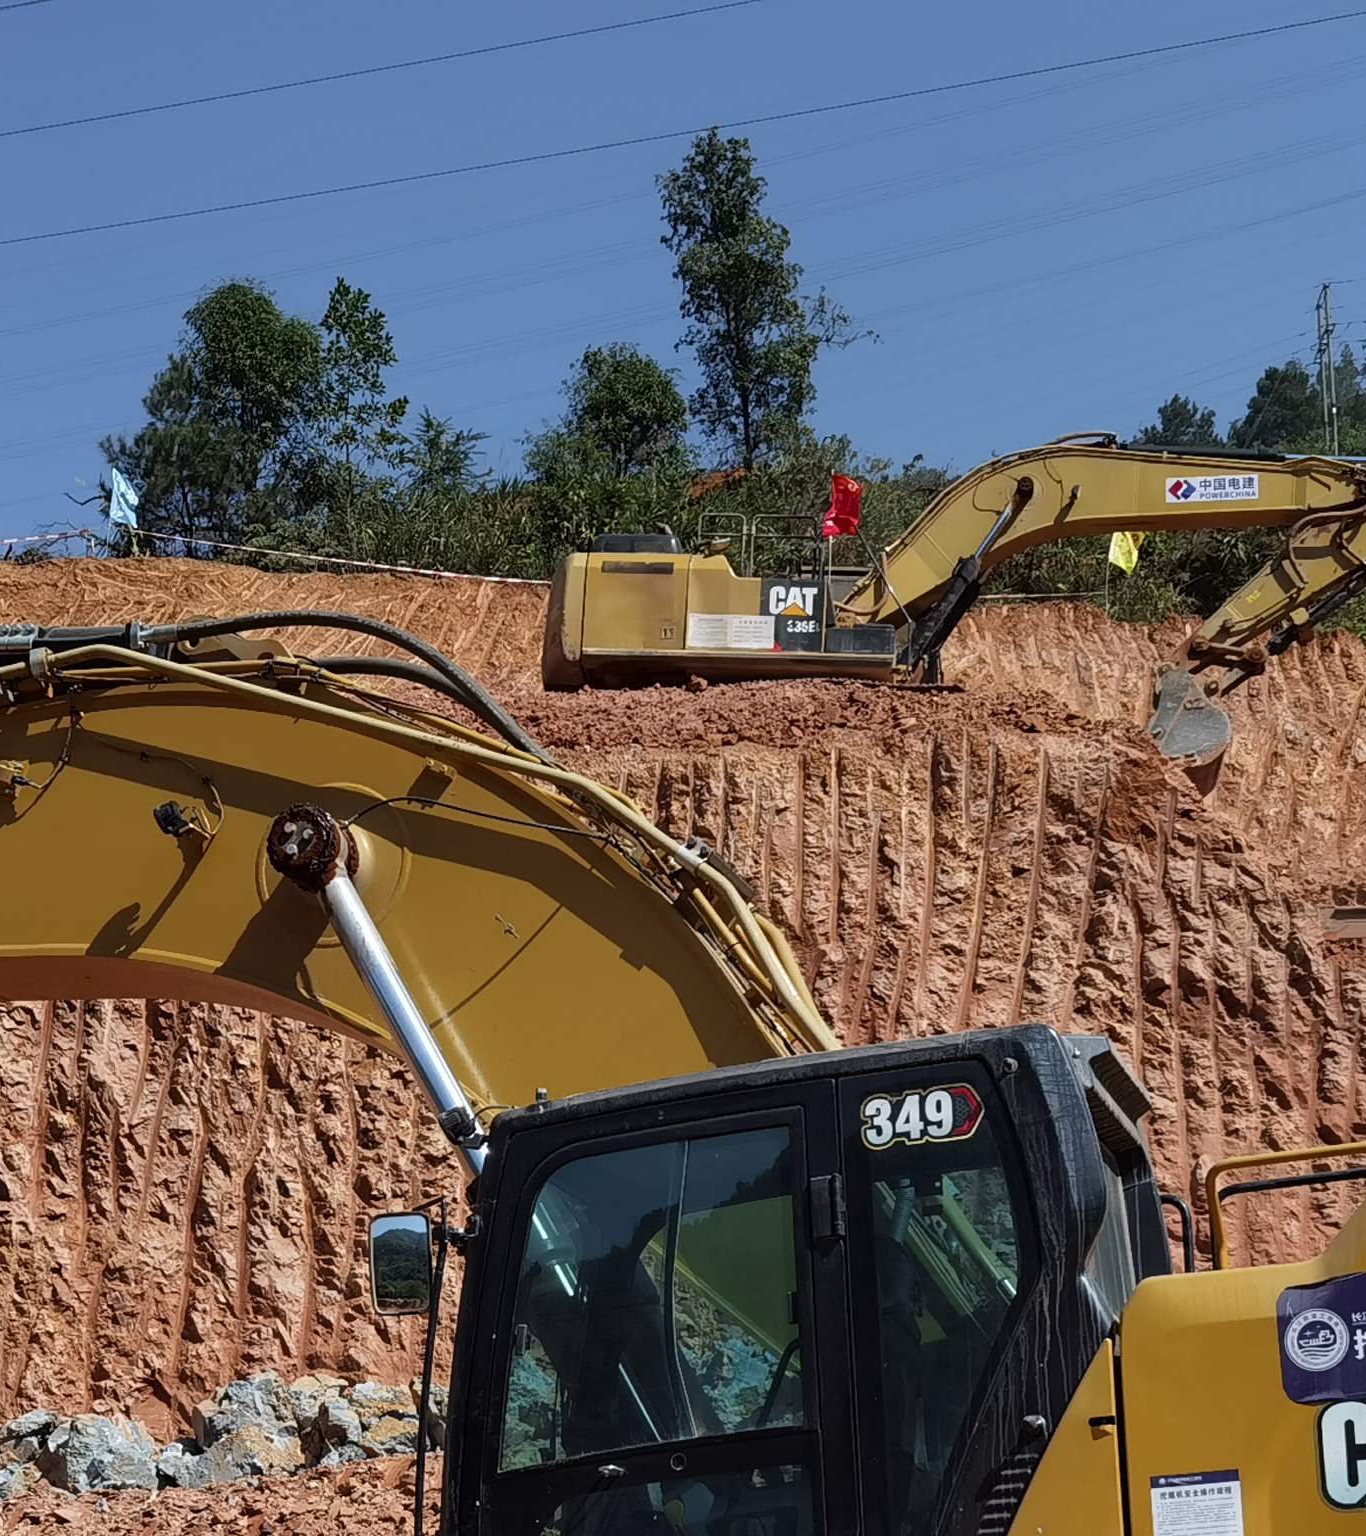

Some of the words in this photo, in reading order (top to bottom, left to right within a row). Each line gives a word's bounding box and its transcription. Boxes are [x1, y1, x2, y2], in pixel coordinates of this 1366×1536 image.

[1199, 476, 1255, 491] 中国电建
[1199, 491, 1257, 499] POWERCHINA
[769, 585, 818, 616] CAT
[865, 1090, 954, 1145] 349
